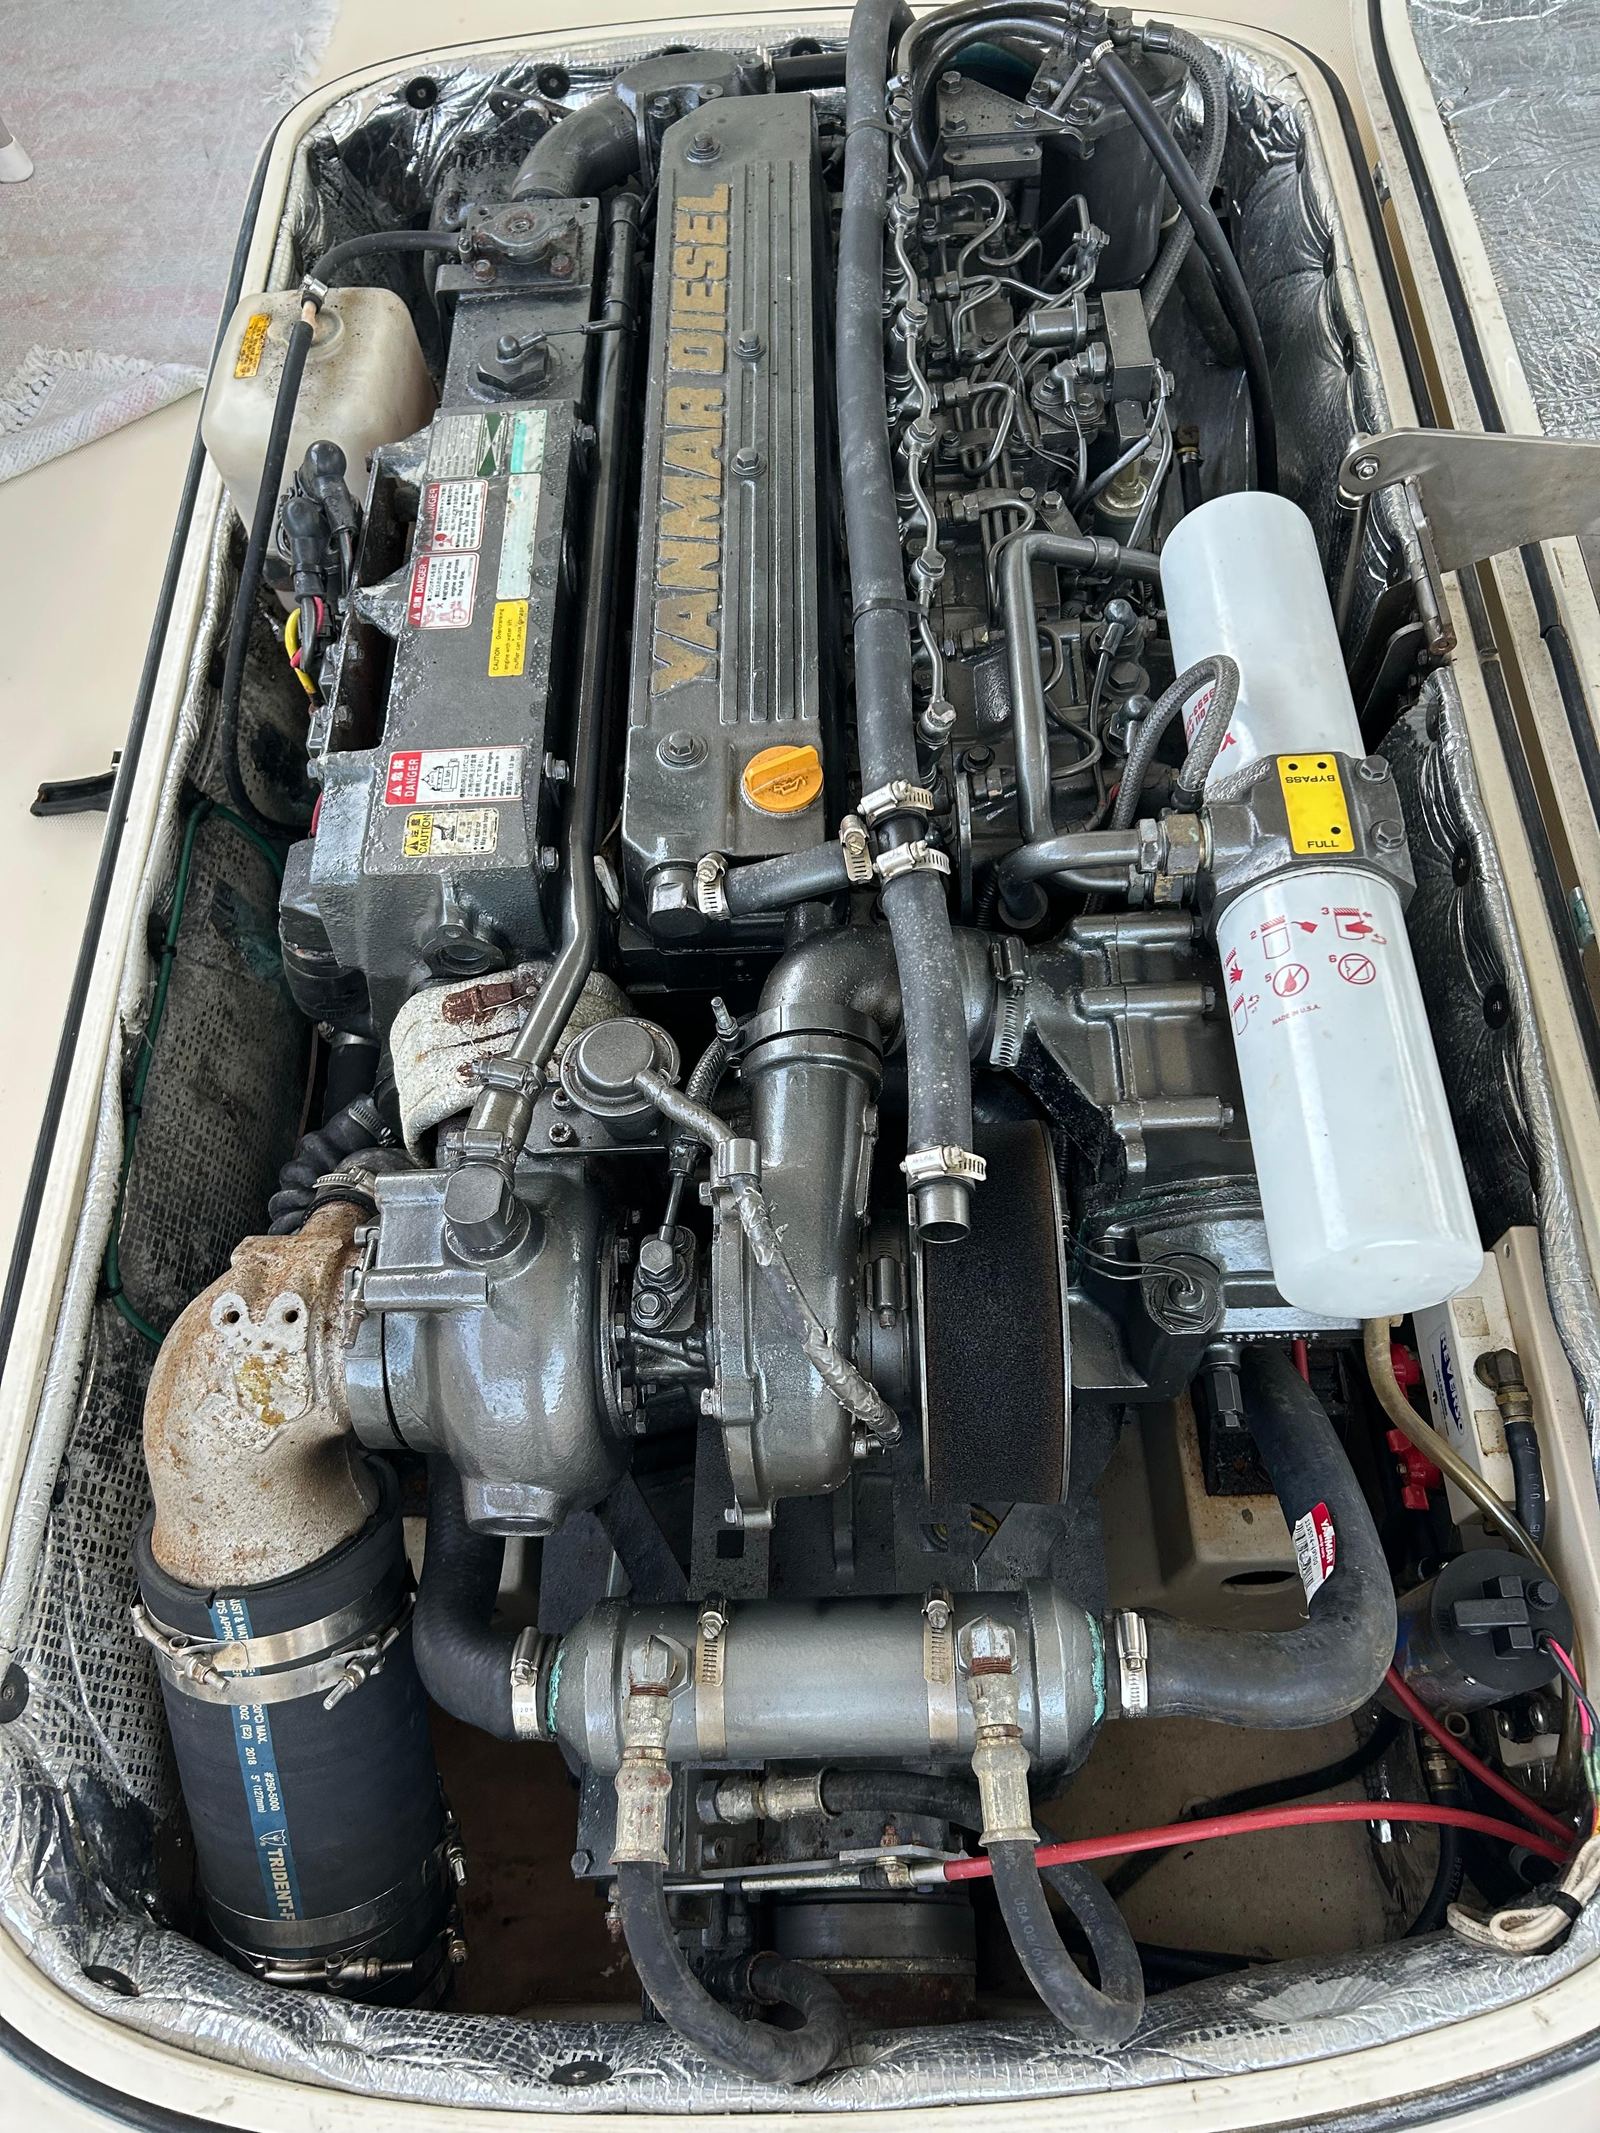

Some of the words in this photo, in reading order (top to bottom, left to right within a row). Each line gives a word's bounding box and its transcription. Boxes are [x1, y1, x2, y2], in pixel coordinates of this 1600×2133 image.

[668, 183, 730, 374] DIESEL
[652, 386, 723, 697] YANMAR
[415, 563, 427, 593] DANGER
[492, 647, 501, 671] CAUTION
[404, 758, 419, 797] DANGER
[1285, 774, 1336, 784] BYPASS
[418, 814, 432, 854] CAUTION
[1307, 840, 1340, 849] FULL
[1321, 906, 1331, 915] 3
[1249, 931, 1258, 940] 2
[1328, 954, 1337, 963] 6
[1264, 973, 1273, 983] 5
[1272, 1013, 1291, 1026] MADE
[1440, 1331, 1465, 1436] REVERSO
[233, 1616, 245, 1624] &
[239, 1724, 254, 1740] (E2)
[244, 1747, 258, 1766] 2018
[256, 1725, 268, 1745] MAX.
[263, 1771, 281, 1812] #250-5000
[252, 1784, 267, 1814] (127mm)
